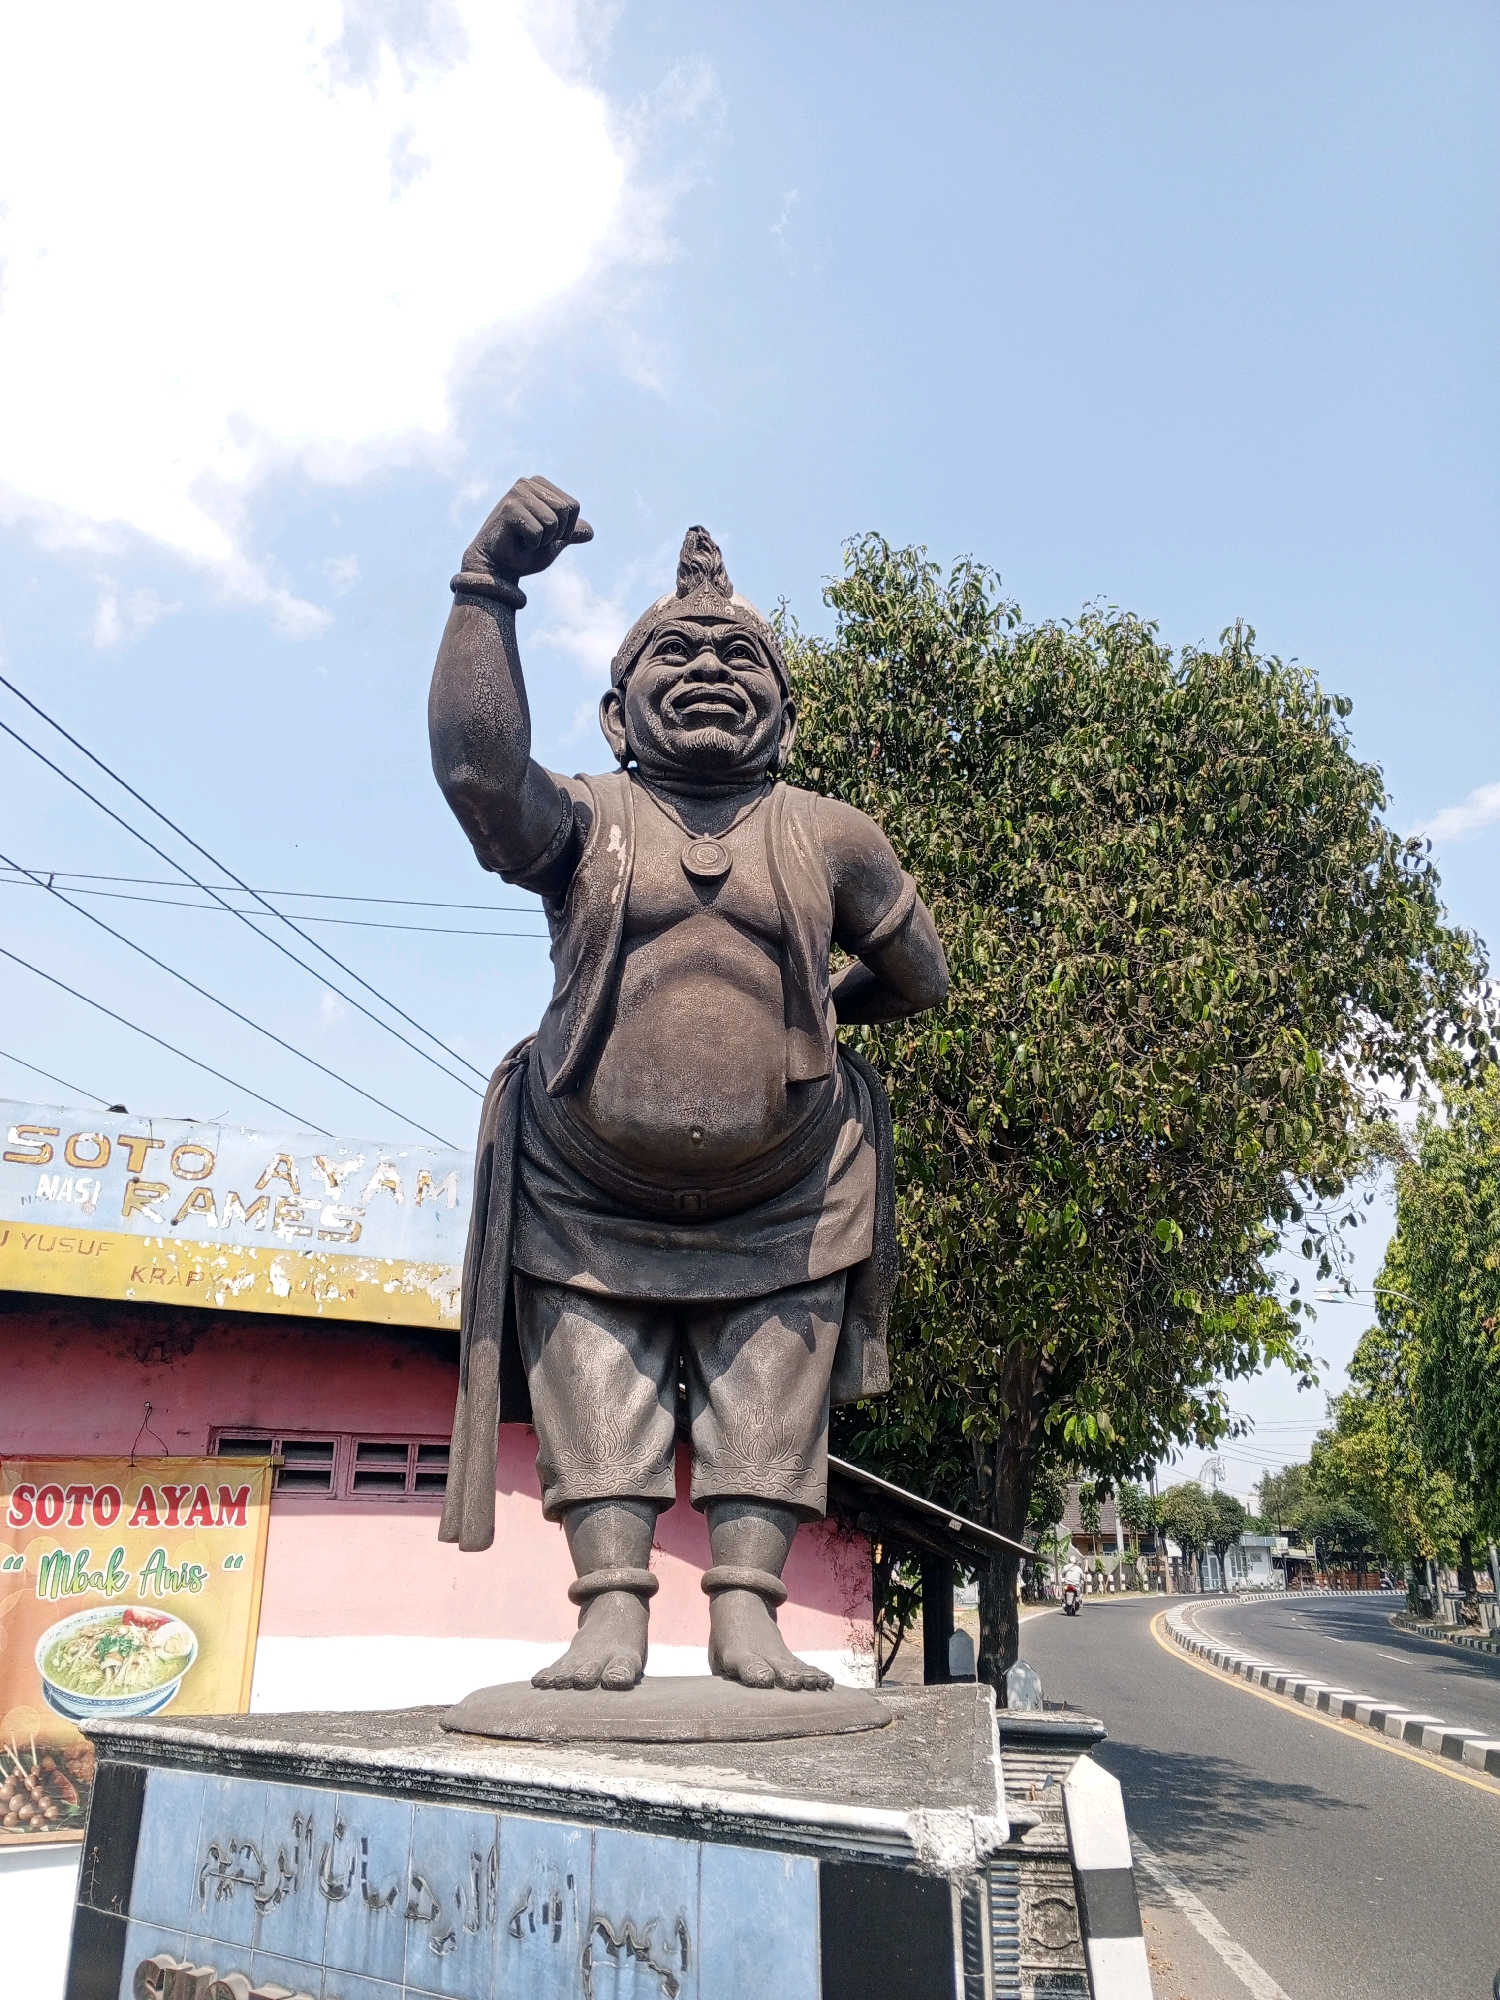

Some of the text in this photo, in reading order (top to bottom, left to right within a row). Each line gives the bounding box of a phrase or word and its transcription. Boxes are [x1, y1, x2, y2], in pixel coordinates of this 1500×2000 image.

[3, 1125, 459, 1210] SOTO AYAM
[36, 1173, 366, 1244] NASI RAMES
[21, 1232, 115, 1257] YUSUF
[8, 1484, 251, 1528] SOTO AYAM
[37, 1548, 131, 1599] Mbak
[138, 1548, 208, 1597] Anis
